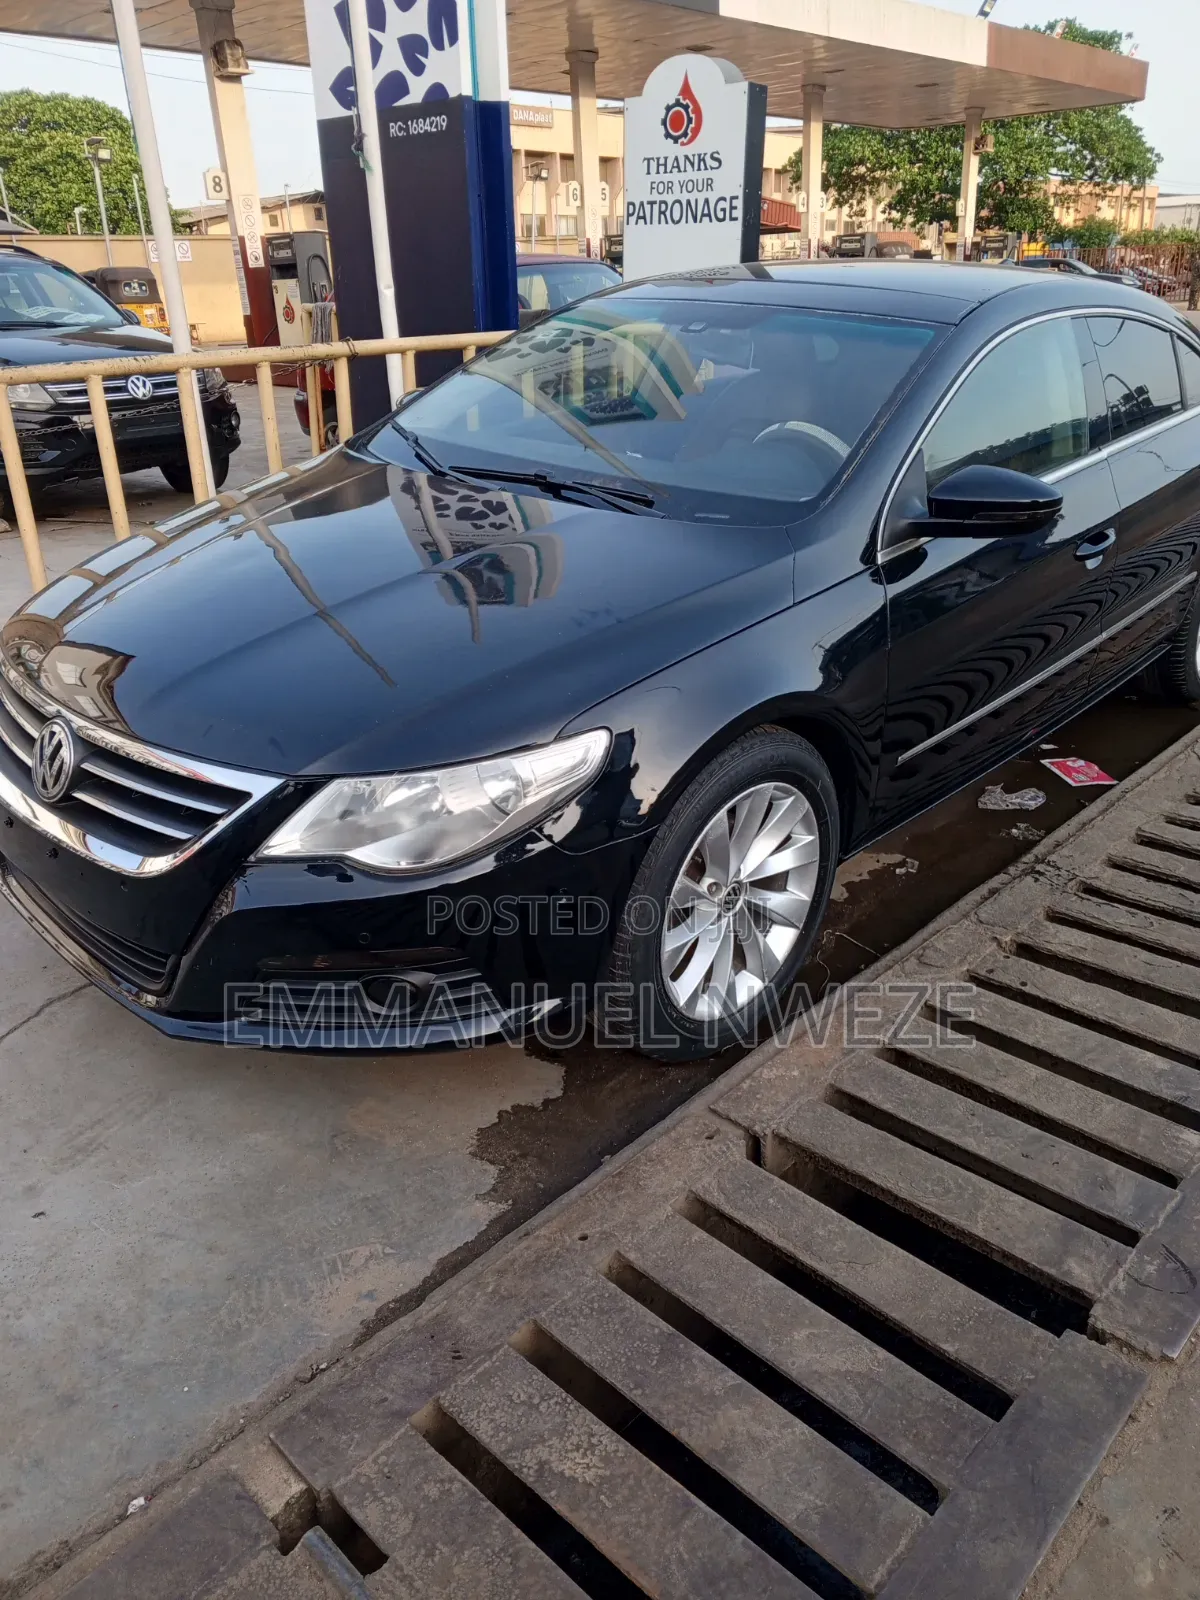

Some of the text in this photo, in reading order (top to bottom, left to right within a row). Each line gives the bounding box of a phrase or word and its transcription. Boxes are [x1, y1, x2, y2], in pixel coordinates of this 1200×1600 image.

[389, 114, 448, 138] RC: 1684219
[642, 150, 723, 176] THANKS
[212, 175, 223, 193] 8
[649, 177, 714, 195] FOR YOUR
[572, 187, 579, 202] 6
[600, 187, 607, 202] 5
[626, 195, 739, 225] PATRONAGE
